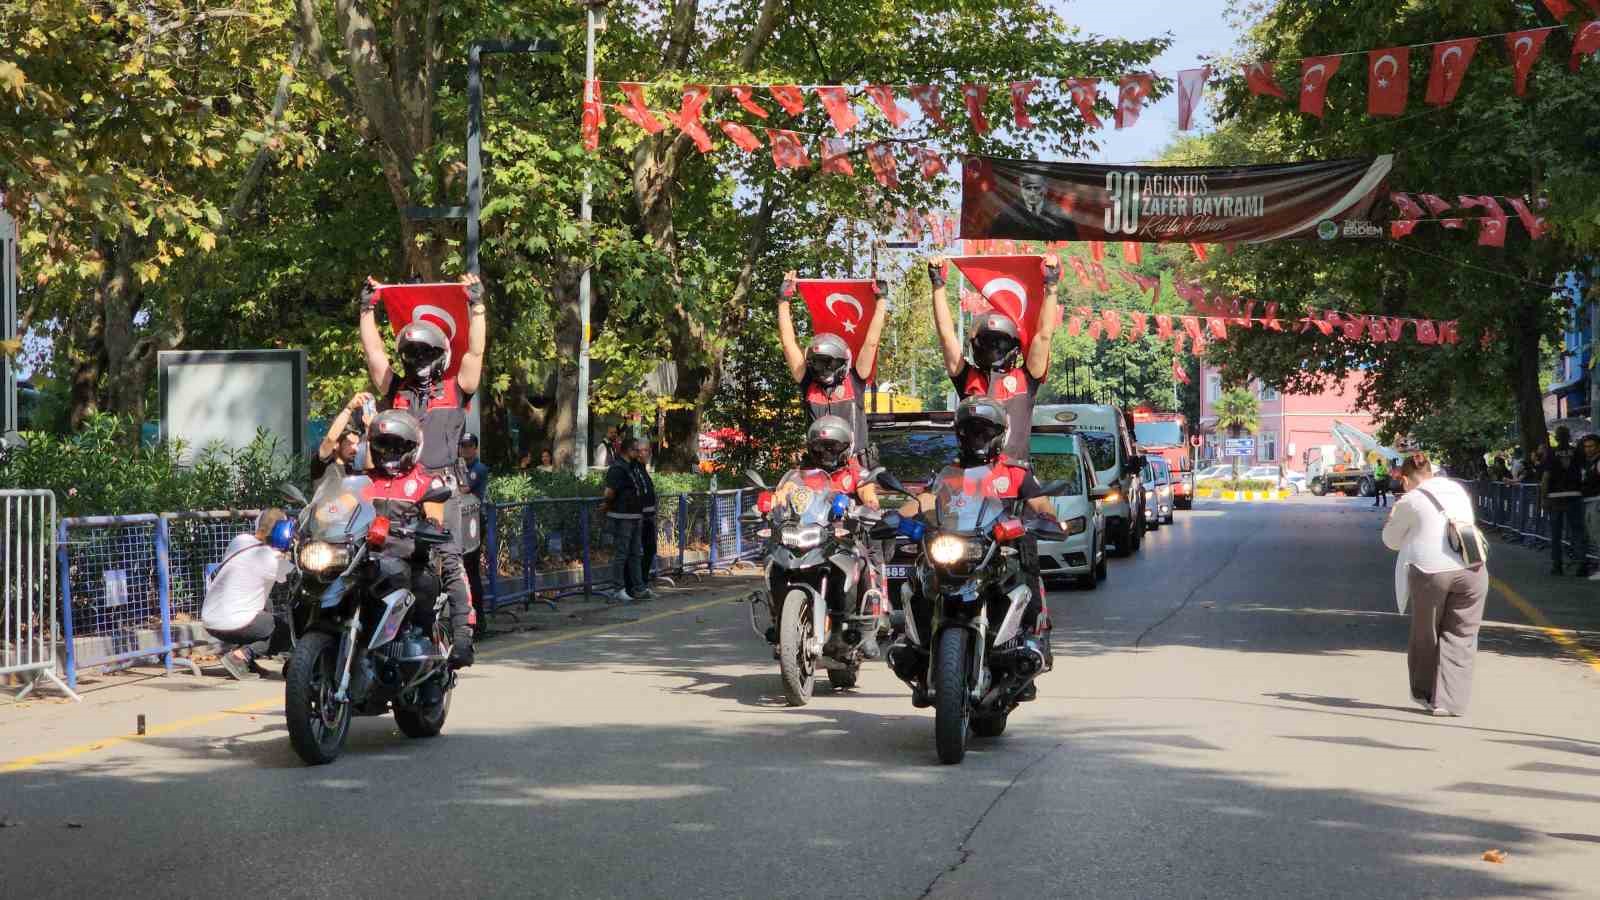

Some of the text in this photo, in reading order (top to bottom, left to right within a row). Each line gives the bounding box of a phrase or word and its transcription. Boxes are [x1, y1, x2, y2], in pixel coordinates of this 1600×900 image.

[1104, 170, 1140, 234] 30
[1141, 195, 1264, 216] ZAFER BAYRAMI
[1139, 214, 1228, 237] Kutlu Olsun
